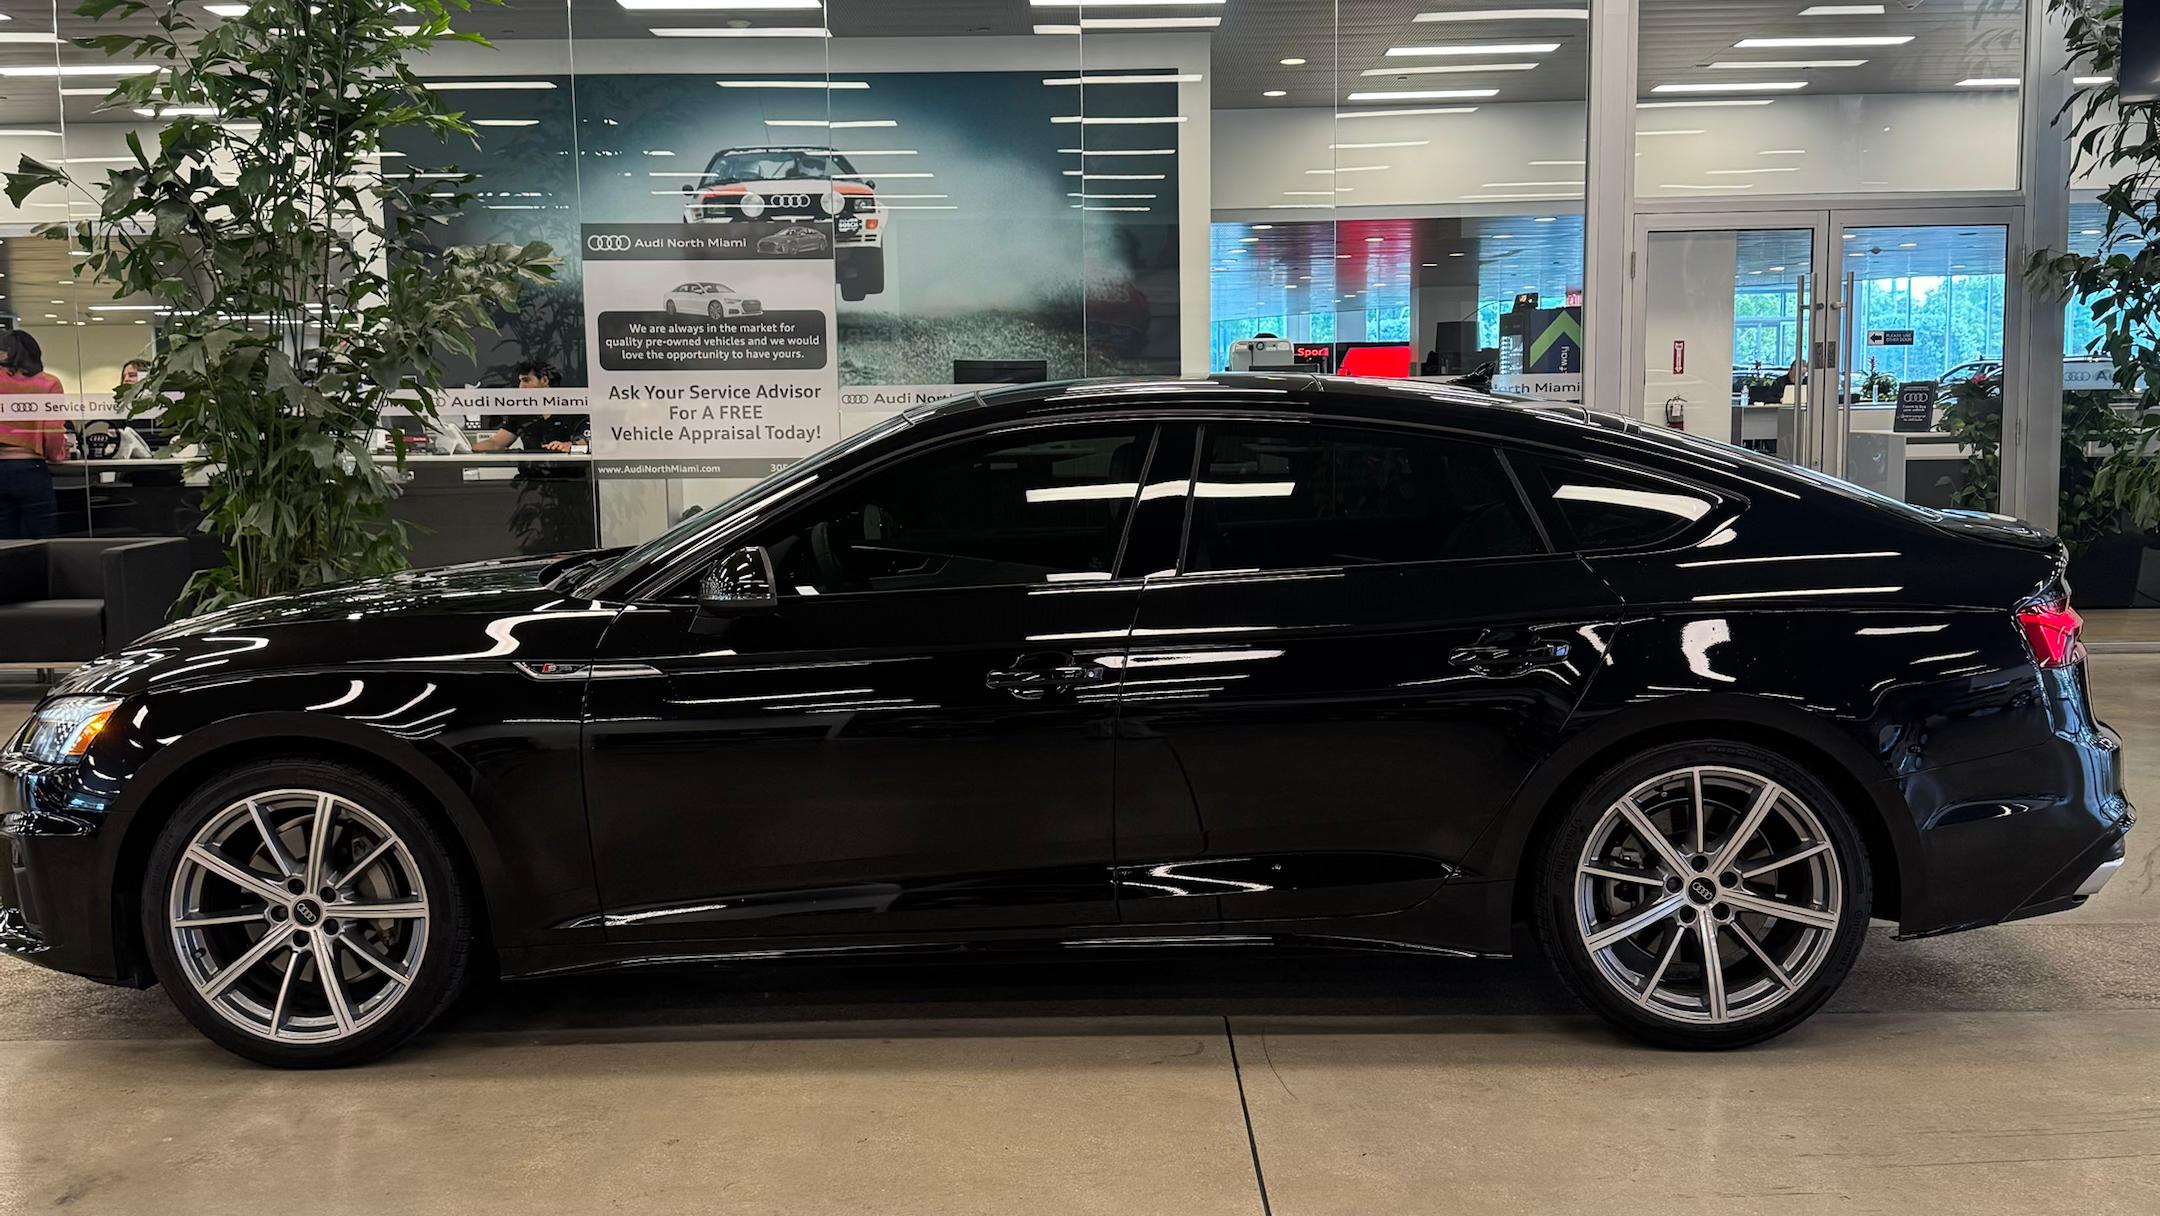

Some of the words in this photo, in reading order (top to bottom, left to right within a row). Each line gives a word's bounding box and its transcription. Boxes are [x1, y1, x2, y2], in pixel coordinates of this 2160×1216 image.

[634, 238, 664, 248] Audi
[667, 238, 704, 248] North
[707, 238, 747, 248] Miami
[629, 323, 647, 334] We
[649, 325, 666, 334] are
[668, 323, 705, 335] always
[706, 323, 717, 333] in
[719, 323, 737, 333] the
[739, 322, 777, 333] market
[780, 322, 795, 332] for
[605, 336, 643, 349] quality
[645, 336, 701, 348] pre-owned
[703, 336, 746, 346] vehicles
[748, 335, 768, 345] and
[787, 335, 820, 345] would
[621, 349, 644, 359] love
[646, 349, 664, 359] the
[666, 349, 730, 361] opportunity
[732, 350, 743, 359] to
[746, 348, 770, 359] have
[772, 350, 805, 360] yours.
[1297, 347, 1329, 357] Spor
[608, 384, 640, 400] Ask
[644, 385, 685, 400] Your
[689, 384, 751, 399] Service
[756, 384, 821, 399] Advisor
[1493, 383, 1530, 393] orth
[1535, 382, 1580, 393] Miami
[451, 395, 489, 407] Audi
[494, 396, 538, 407] North
[543, 396, 588, 407] Miami
[873, 392, 911, 404] Audi
[916, 393, 952, 404] Nor
[44, 401, 85, 412] Service
[89, 401, 119, 412] Drive
[669, 405, 697, 420] For
[702, 405, 714, 420] A
[719, 405, 763, 419] FREE
[611, 425, 673, 441] Vehicle
[679, 425, 760, 444] Appraisal
[765, 425, 821, 443] Today!
[598, 464, 721, 473] www.AudiNorthMiami.com
